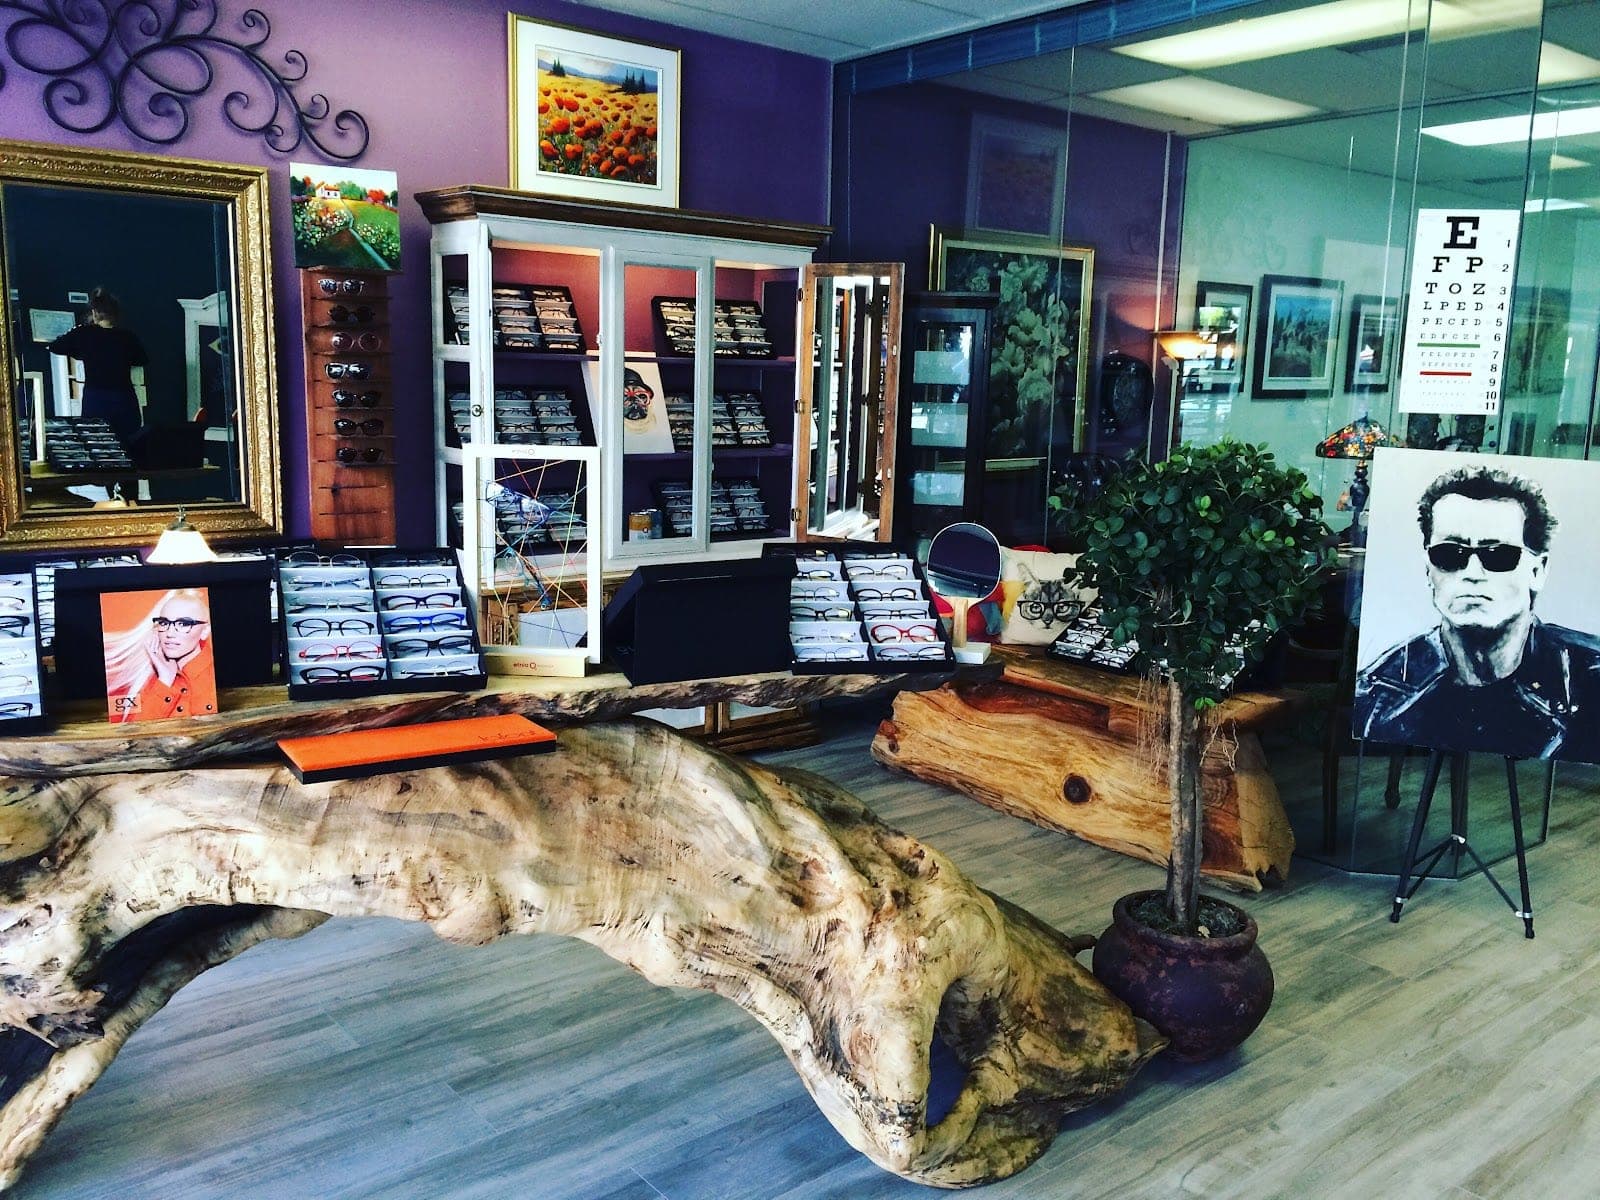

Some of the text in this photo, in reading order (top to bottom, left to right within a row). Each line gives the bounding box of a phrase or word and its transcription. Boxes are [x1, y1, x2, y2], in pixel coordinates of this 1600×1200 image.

[1443, 216, 1511, 249] E 1
[1502, 264, 1509, 272] 2
[1499, 286, 1507, 295] 3
[1497, 302, 1504, 311] 4
[1495, 318, 1503, 327] 5
[1493, 333, 1501, 342] 6
[1492, 350, 1499, 360] 7
[1490, 363, 1497, 373] 8
[1488, 379, 1496, 387] 9
[1485, 391, 1497, 400] 10
[1485, 402, 1495, 410] 11
[115, 697, 139, 713] gx
